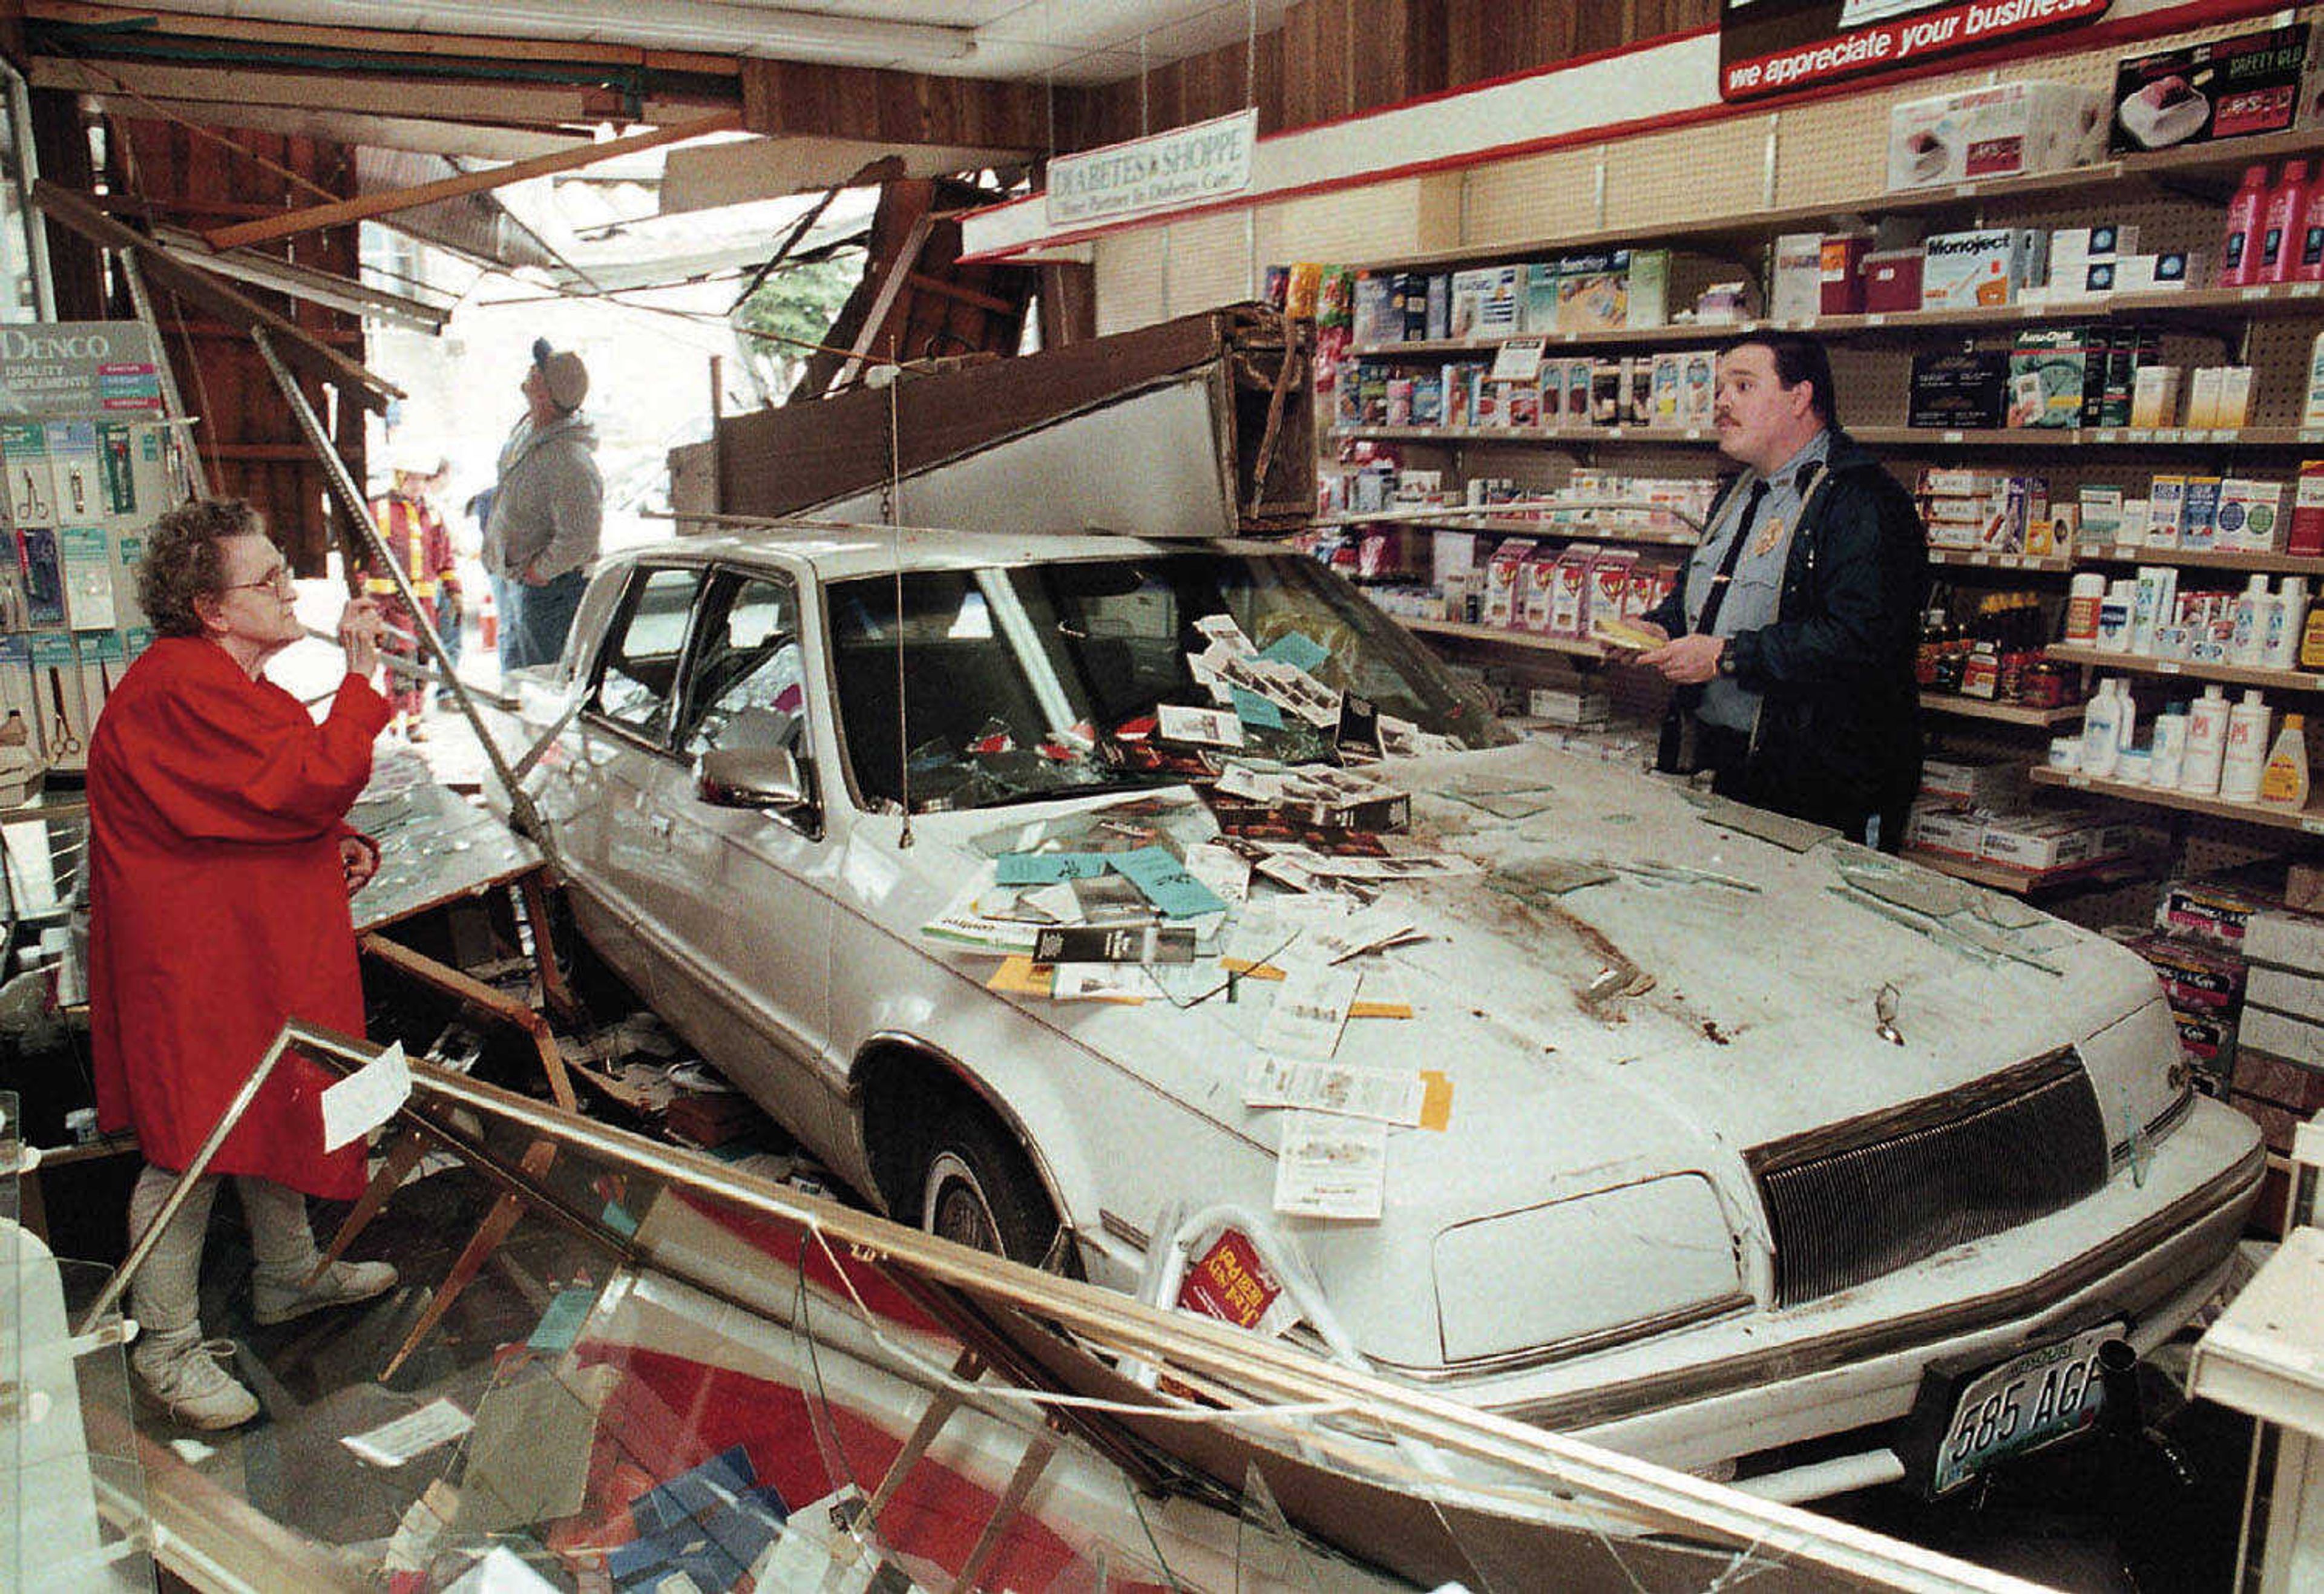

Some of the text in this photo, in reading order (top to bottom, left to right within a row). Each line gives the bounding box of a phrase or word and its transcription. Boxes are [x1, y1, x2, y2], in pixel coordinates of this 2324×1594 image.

[1728, 64, 1759, 90] we
[1764, 30, 1891, 83] appreciate
[1898, 16, 1961, 56] your
[1928, 234, 2011, 256] Monoject
[1952, 1380, 2026, 1463] 585
